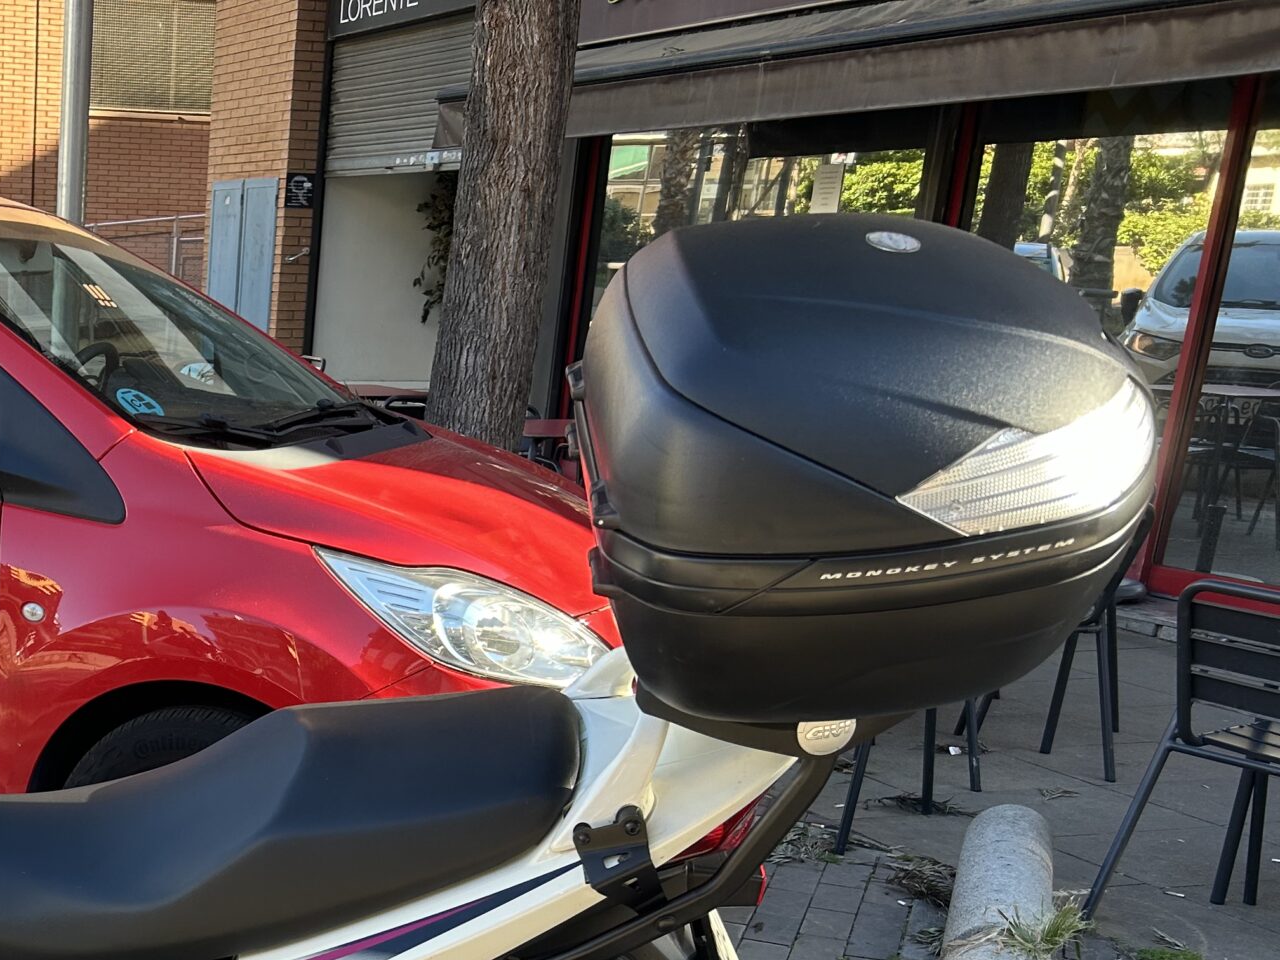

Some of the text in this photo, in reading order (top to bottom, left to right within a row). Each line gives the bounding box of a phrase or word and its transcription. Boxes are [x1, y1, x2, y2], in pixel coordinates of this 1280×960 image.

[340, 0, 419, 24] LOREN
[820, 538, 1075, 579] MONOKEY SYSTEM
[805, 720, 852, 740] GIVI
